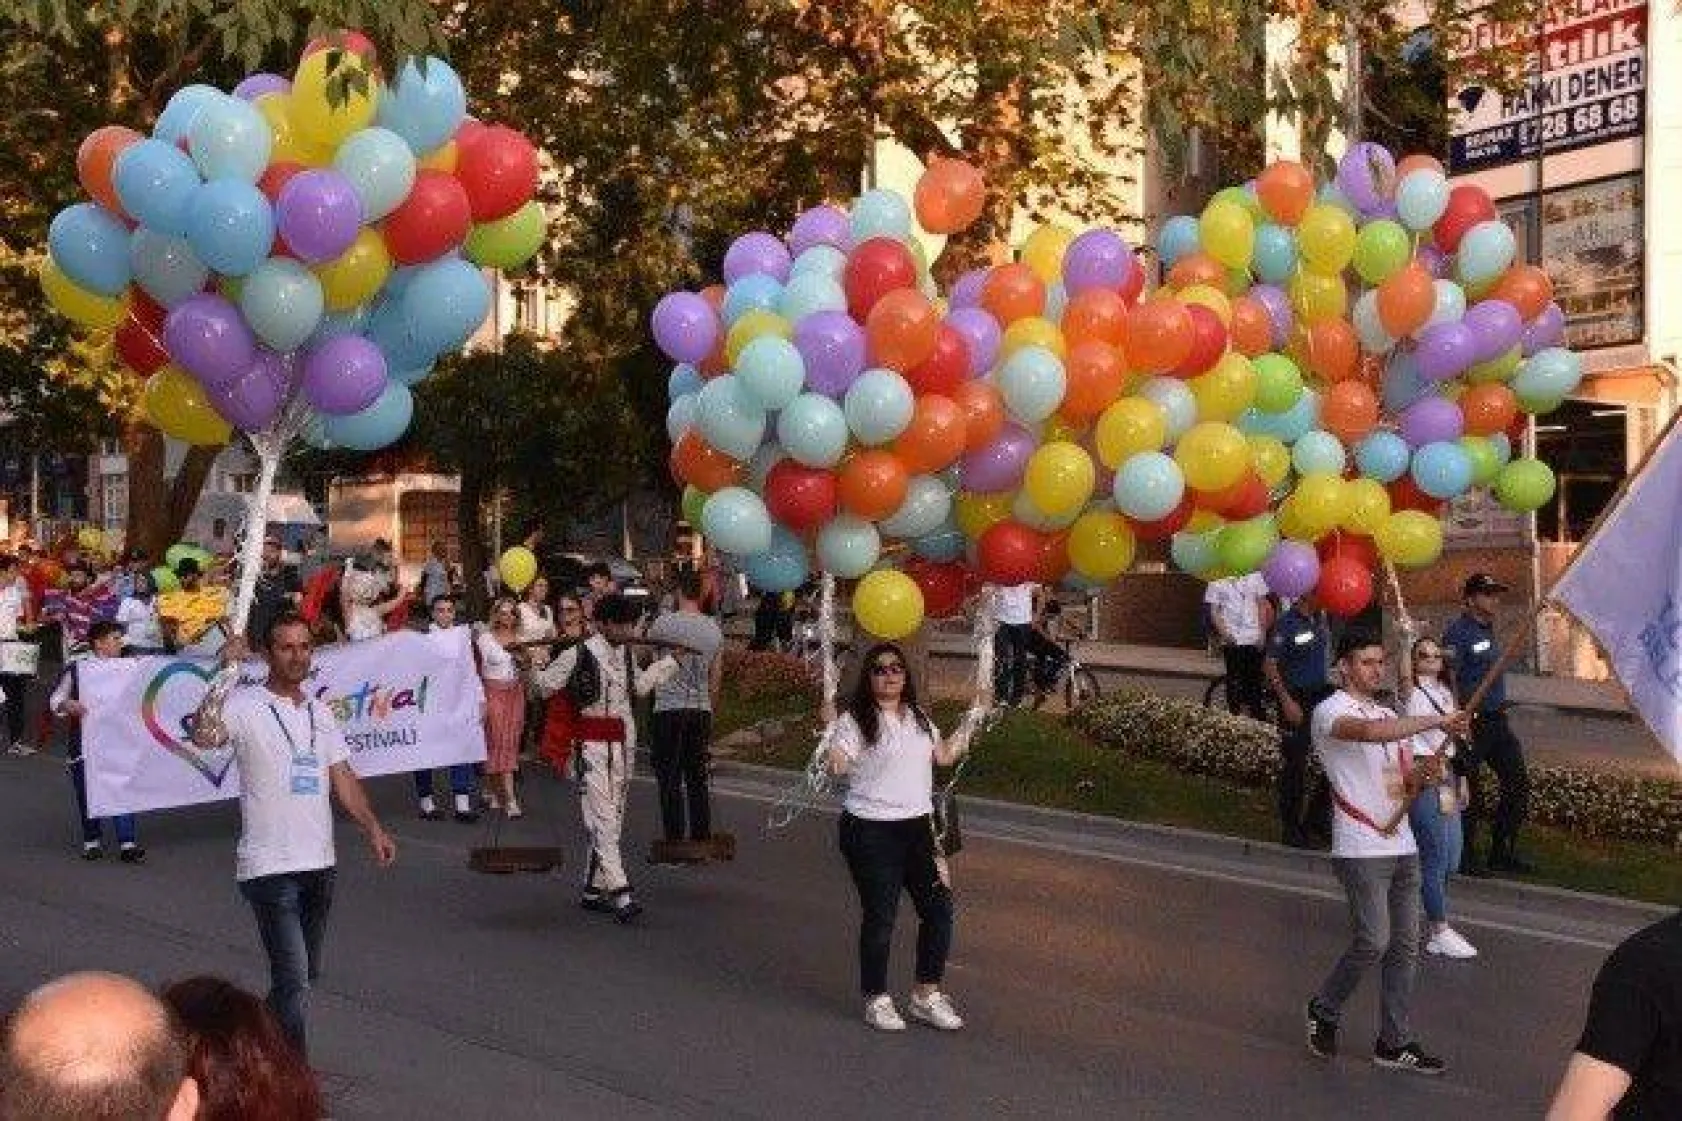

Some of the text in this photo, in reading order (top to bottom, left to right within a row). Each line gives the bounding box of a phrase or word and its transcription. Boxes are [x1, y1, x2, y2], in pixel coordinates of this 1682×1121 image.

[1568, 57, 1642, 101] DENER
[1574, 104, 1603, 132] 68
[1610, 95, 1639, 124] 68
